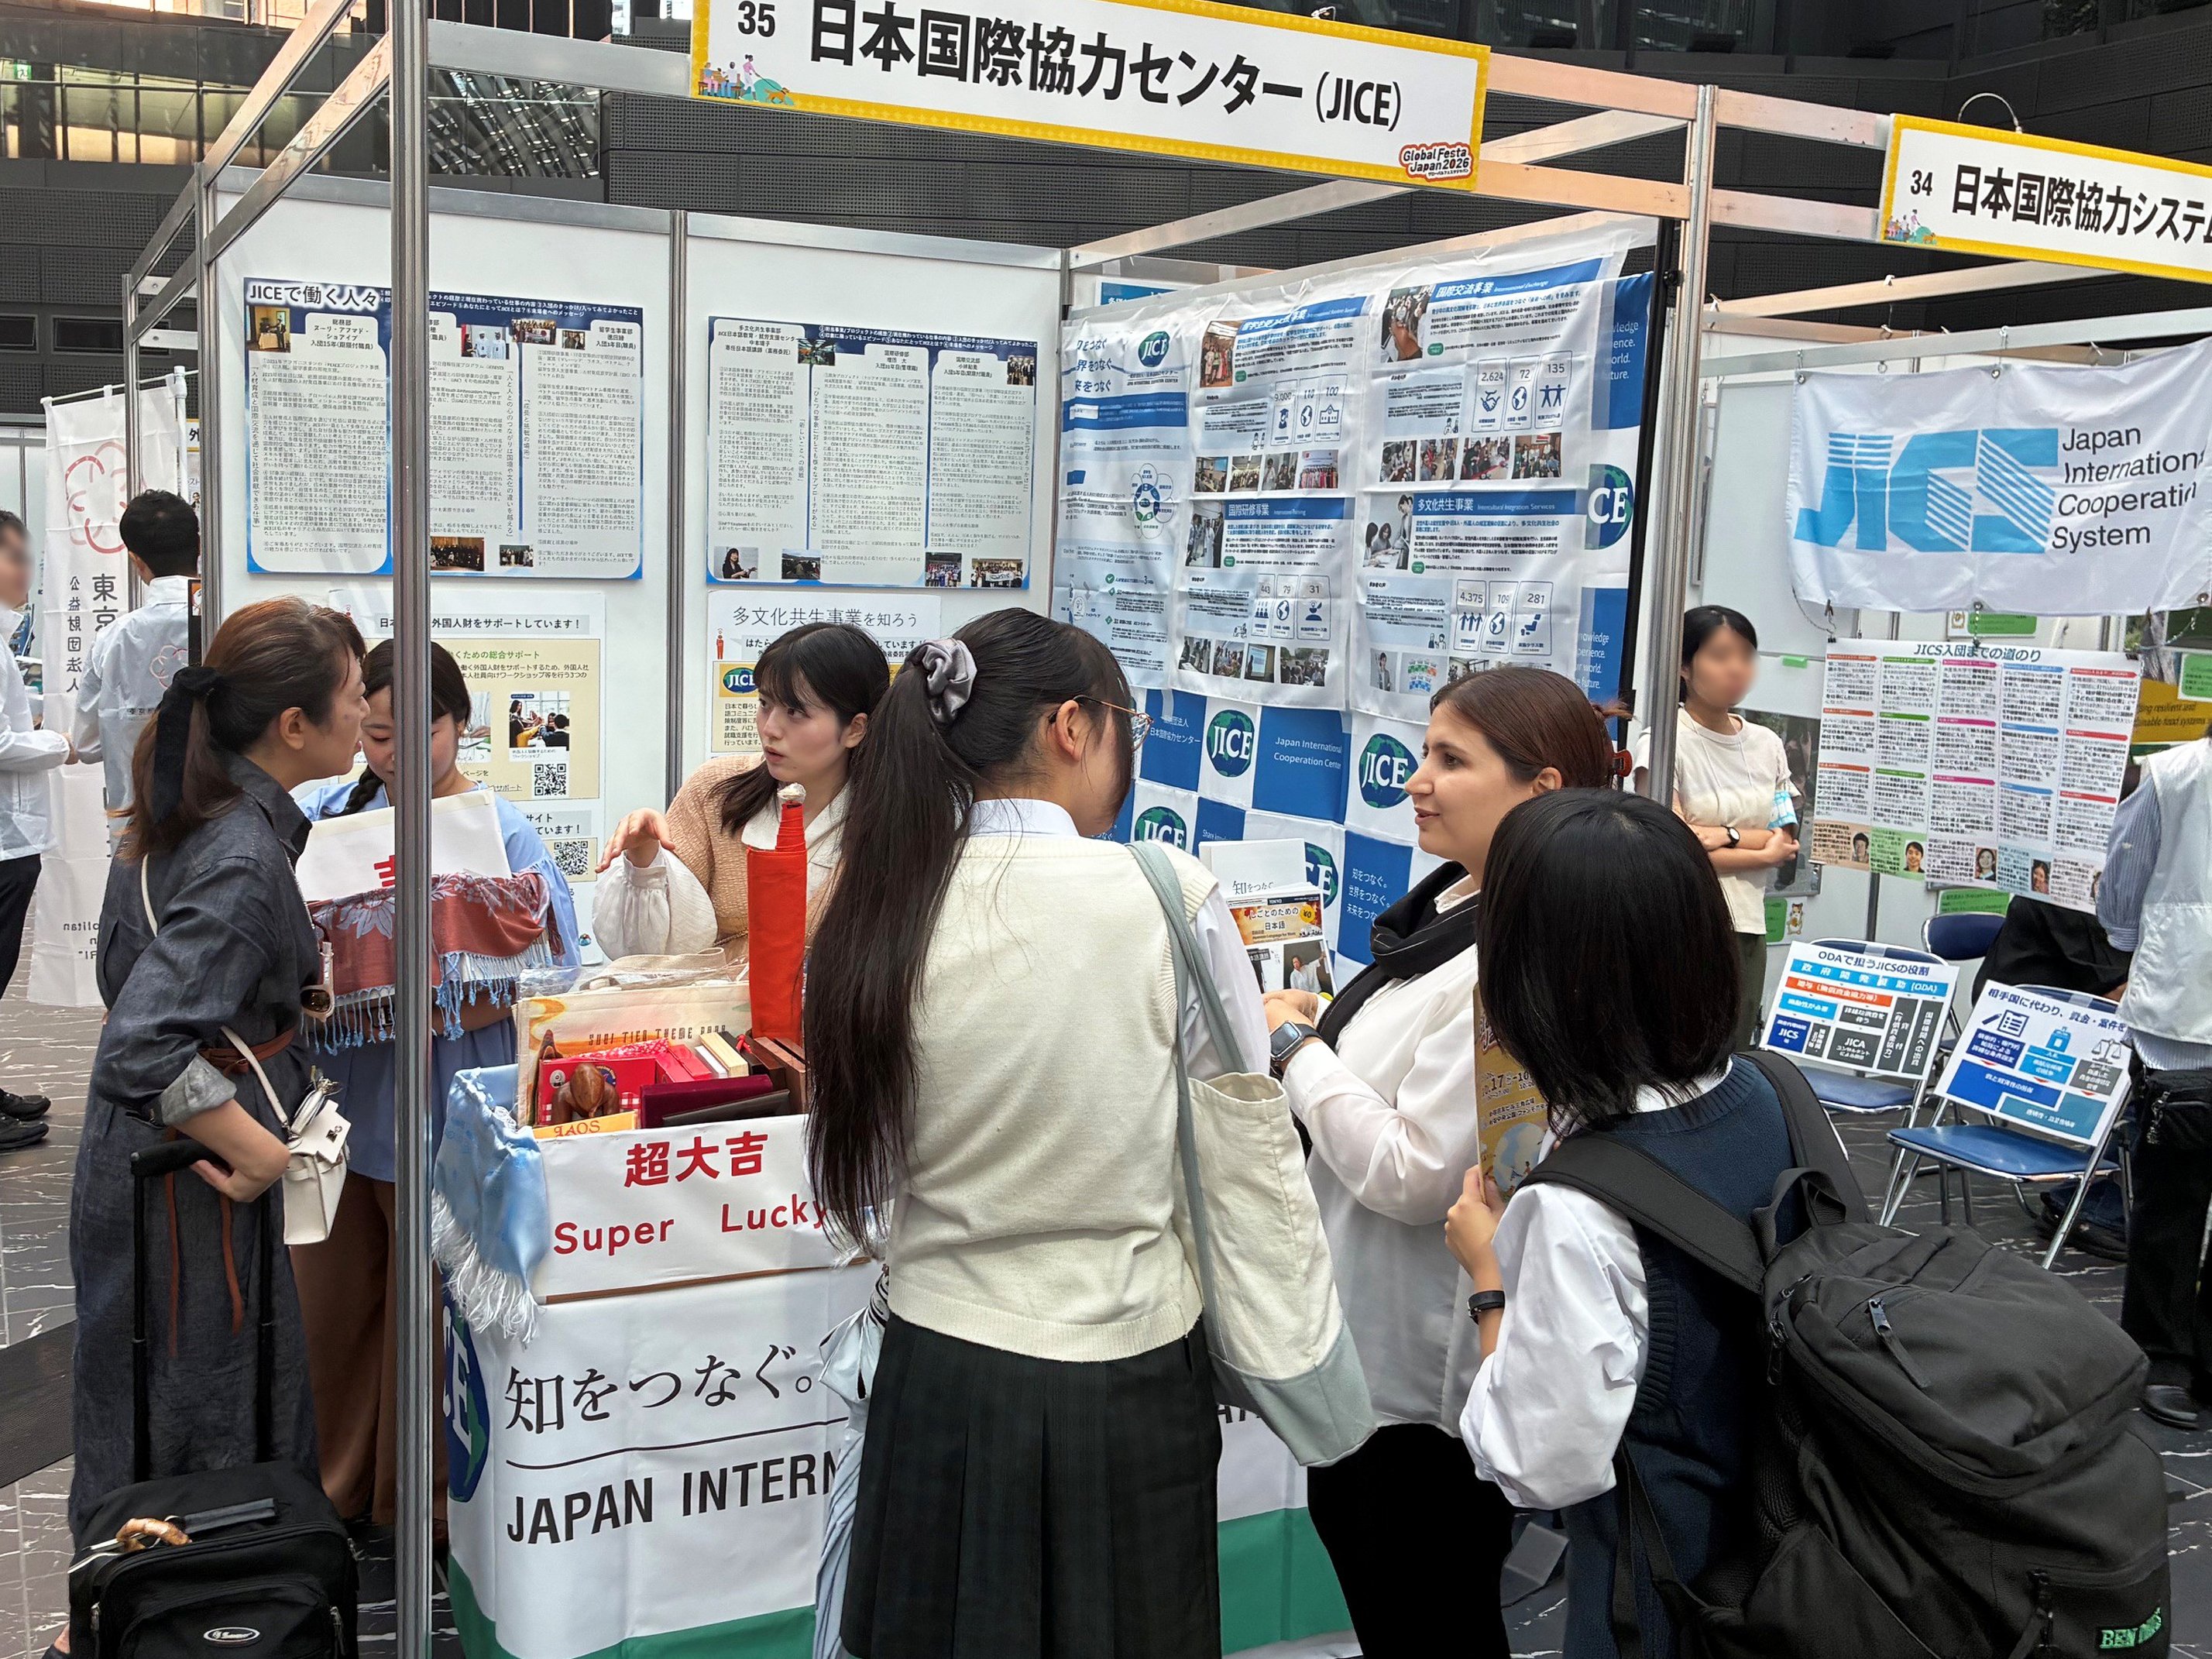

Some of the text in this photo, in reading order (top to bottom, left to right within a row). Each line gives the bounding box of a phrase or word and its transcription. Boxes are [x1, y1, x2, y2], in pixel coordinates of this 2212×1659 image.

[737, 0, 775, 38] 35
[1403, 146, 1467, 162] Global Festa
[1410, 157, 1470, 173] Japan 2026
[1910, 169, 1933, 197] 34
[1952, 164, 2212, 245] 日本国際協力システ
[249, 284, 377, 307] JICEで働く人々
[1435, 281, 1495, 298] 国際交流事業
[1520, 369, 1530, 379] 72
[1547, 363, 1565, 374] 135
[2063, 428, 2142, 455] Japan
[1794, 428, 2059, 554] JICS
[1228, 503, 1269, 517] 国際研修事業
[1417, 497, 1474, 512] 多文化共生事業
[1589, 486, 1628, 524] CE
[2052, 525, 2151, 555] System
[1309, 585, 1320, 594] 31
[1460, 591, 1483, 604] 4,375
[1527, 593, 1545, 605] 281
[431, 617, 580, 629] 外国人財をサポートしています!
[732, 606, 918, 627] 多文化共生事業を知ろう
[449, 650, 540, 660] くための総合サポート
[1913, 644, 2041, 663] JICS入団までの道のり
[1212, 725, 1252, 761] JICE
[1275, 737, 1343, 754] Japan International
[1273, 752, 1342, 770] Cooperation Center
[1362, 751, 1409, 789] JICE
[527, 813, 552, 823] サイト
[535, 824, 580, 836] ています!
[1249, 907, 1300, 919] しごとのための
[1264, 921, 1286, 930] 日本語
[1818, 950, 1930, 977] ODAで担うJICSの役割
[1987, 988, 2128, 1034] 相手国に代わり、資金・案件を
[655, 1026, 692, 1040] THEME
[1778, 1029, 1798, 1039] JICS
[1844, 1037, 1865, 1048] JICA
[623, 1130, 768, 1189] 超大吉
[552, 1194, 827, 1257] Super Lucky
[442, 1305, 472, 1455] E
[505, 1344, 812, 1434] 知をつなぐ。
[507, 1476, 654, 1545] JAPAN
